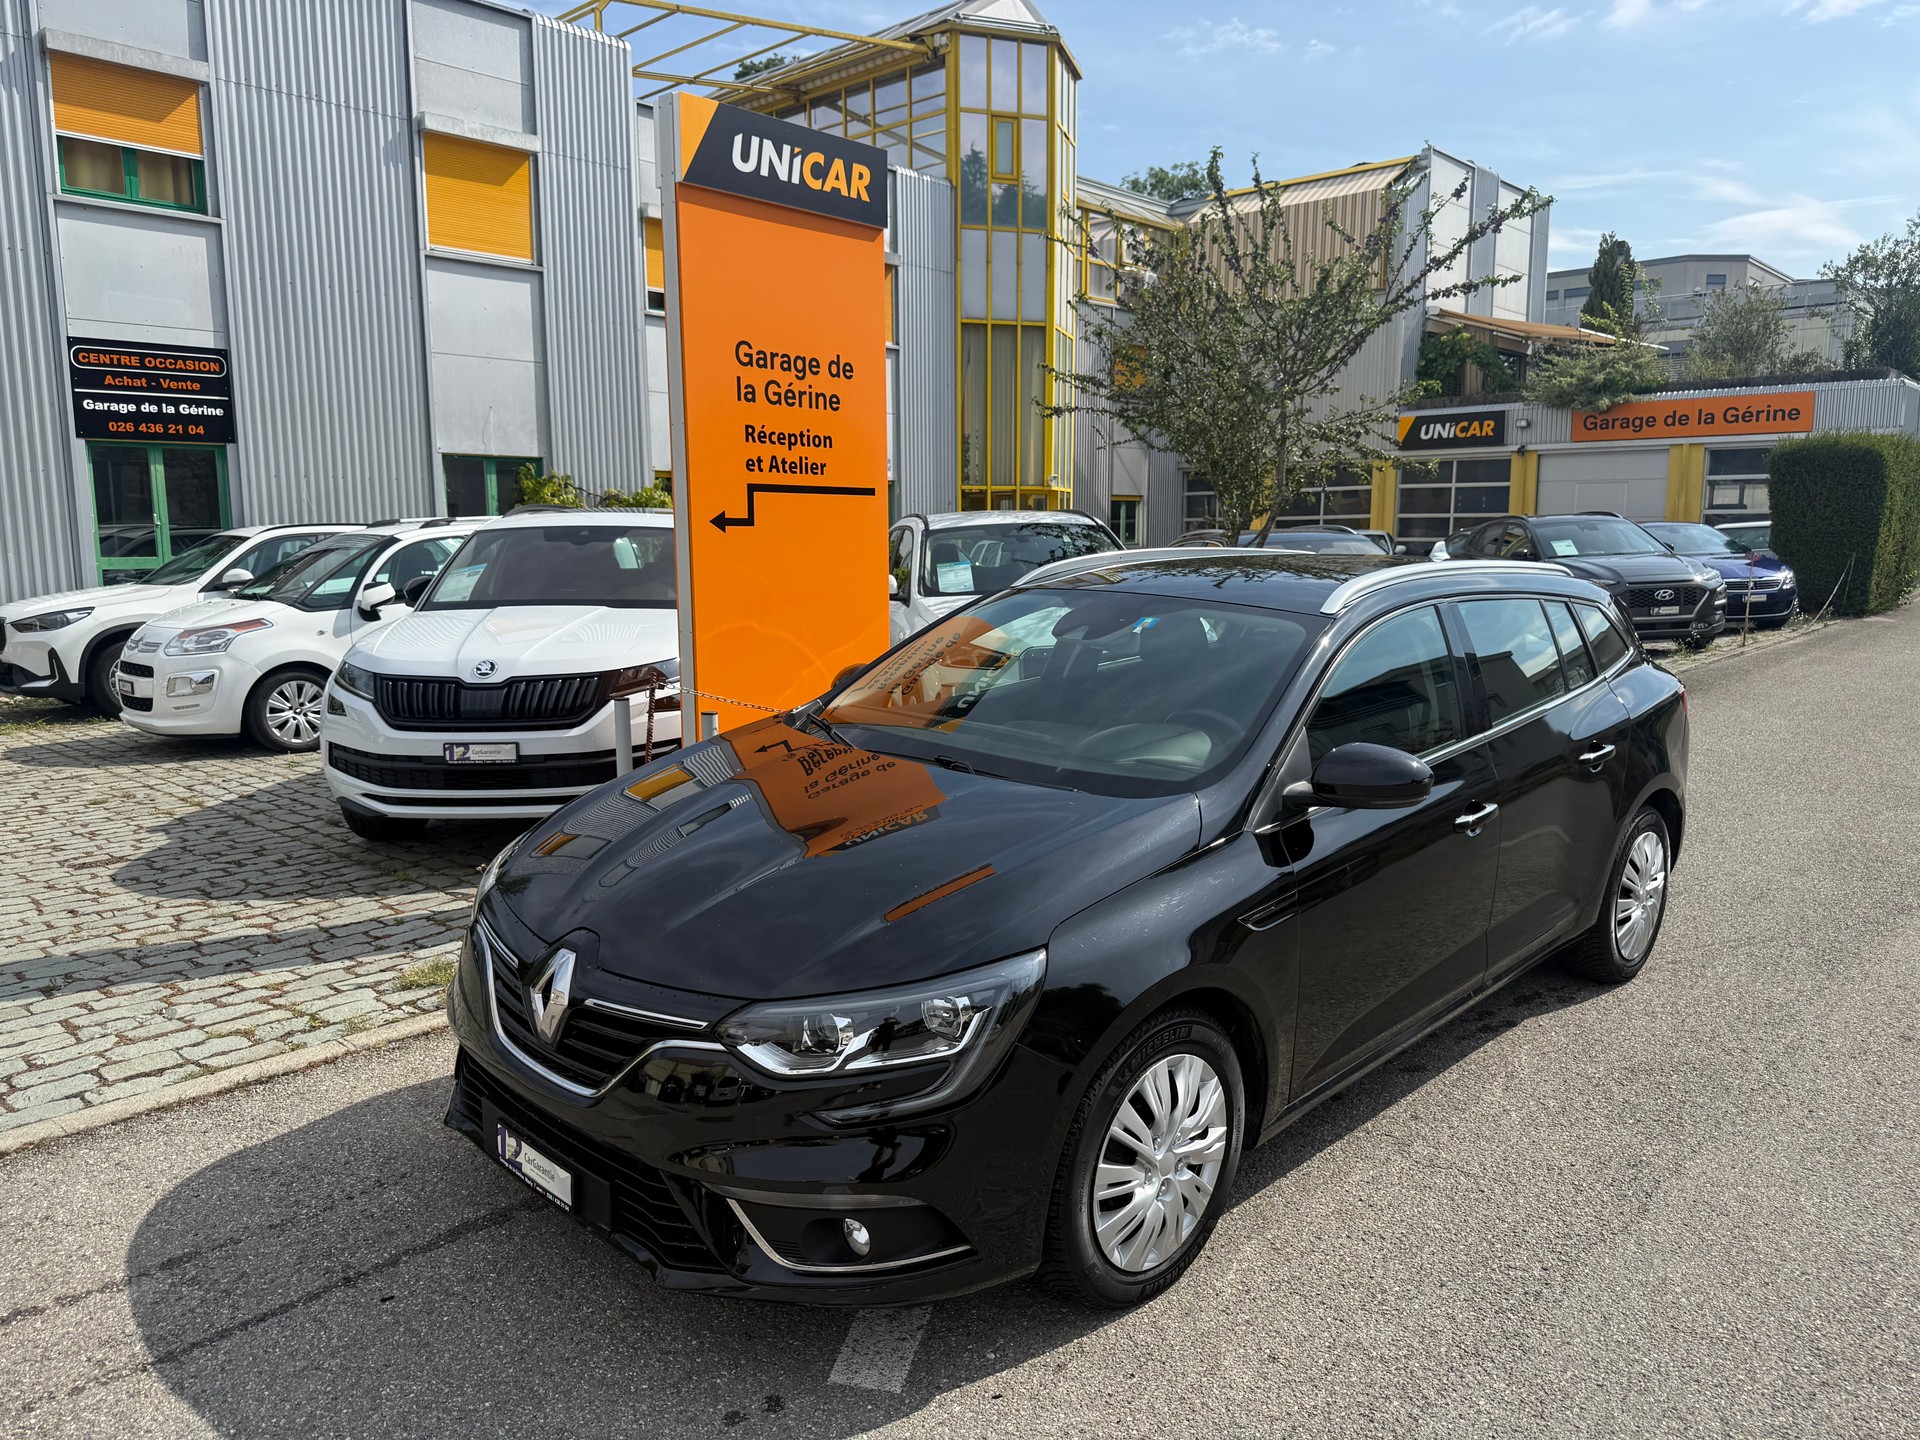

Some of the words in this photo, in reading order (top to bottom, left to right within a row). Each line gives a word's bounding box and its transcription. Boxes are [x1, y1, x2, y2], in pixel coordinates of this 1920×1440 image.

[78, 352, 141, 367] CENTRE
[144, 357, 220, 372] OCCASION
[735, 340, 821, 381] Garage
[828, 354, 854, 380] de
[104, 375, 148, 388] Achat
[159, 378, 201, 391] Vente
[736, 376, 756, 403] la
[764, 380, 841, 412] Gérine
[82, 399, 137, 414] Garage
[140, 402, 158, 413] de
[162, 403, 175, 414] la
[179, 404, 225, 416] Gérine
[1583, 414, 1657, 433] Garage
[1663, 410, 1690, 427] de
[1697, 409, 1715, 425] la
[1722, 405, 1801, 424] Gérine
[108, 421, 134, 432] 026
[138, 422, 164, 434] 436
[168, 424, 184, 434] 21
[188, 425, 205, 435] 04
[745, 424, 833, 451] Réception
[745, 455, 764, 473] et
[768, 454, 827, 476] Atelier
[1131, 1027, 1189, 1072] MICHELIN
